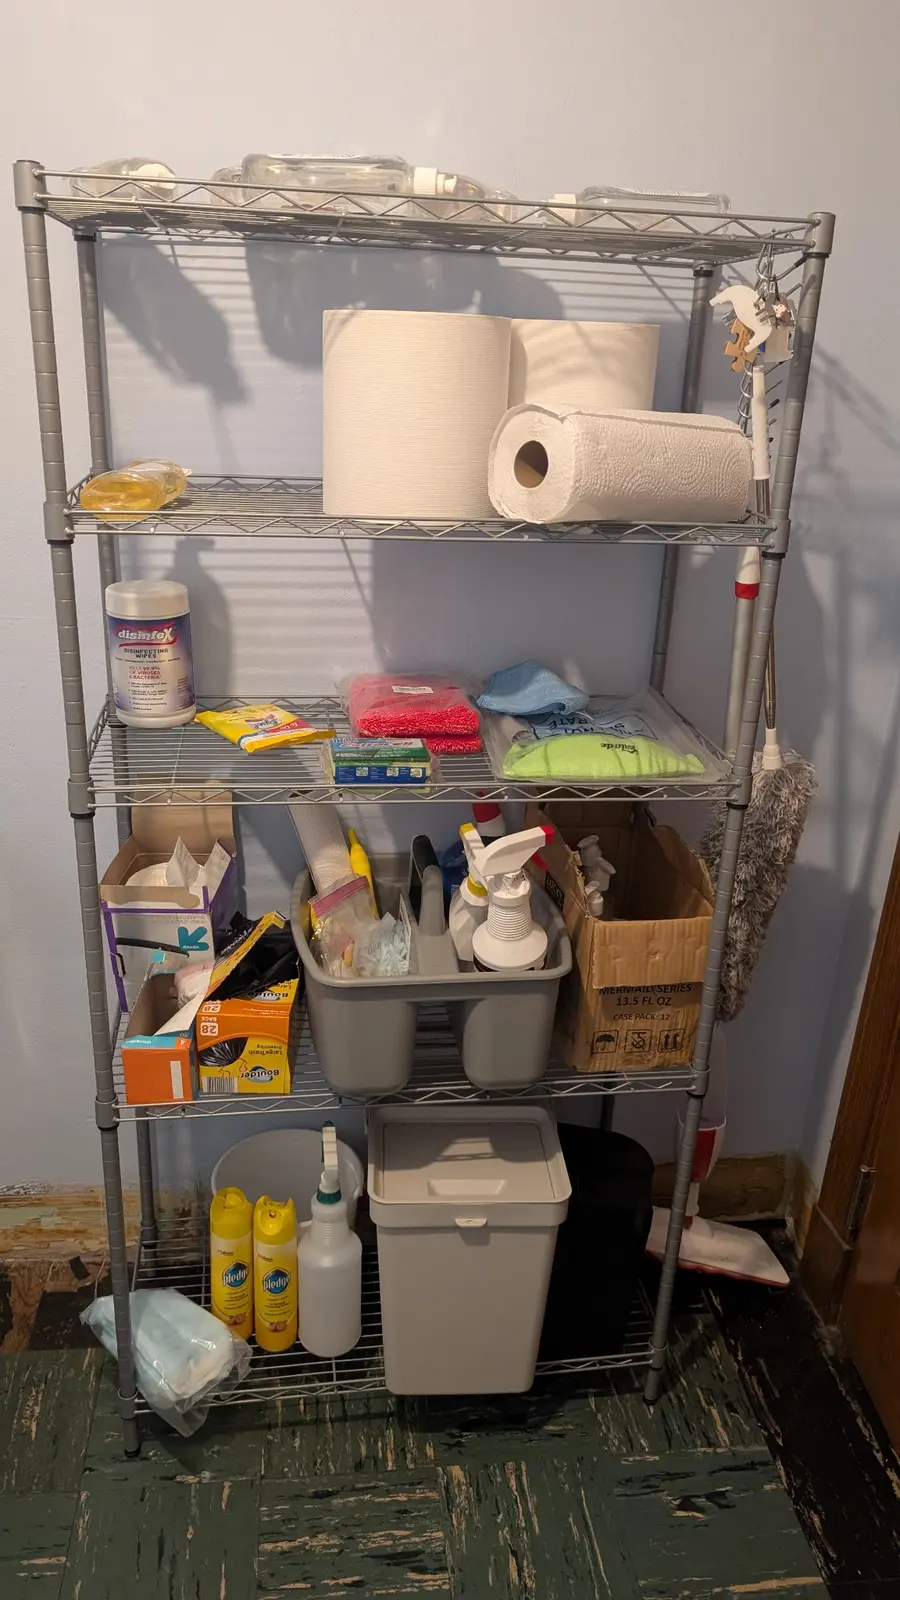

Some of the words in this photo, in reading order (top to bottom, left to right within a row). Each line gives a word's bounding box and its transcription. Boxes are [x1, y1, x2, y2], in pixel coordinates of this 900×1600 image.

[599, 985, 655, 995] MERMAID
[656, 984, 692, 993] SERIES
[616, 997, 639, 1006] 13.5
[642, 997, 654, 1005] FL
[656, 997, 672, 1006] OZ
[201, 1025, 216, 1034] 28
[241, 1070, 280, 1079] Boulder
